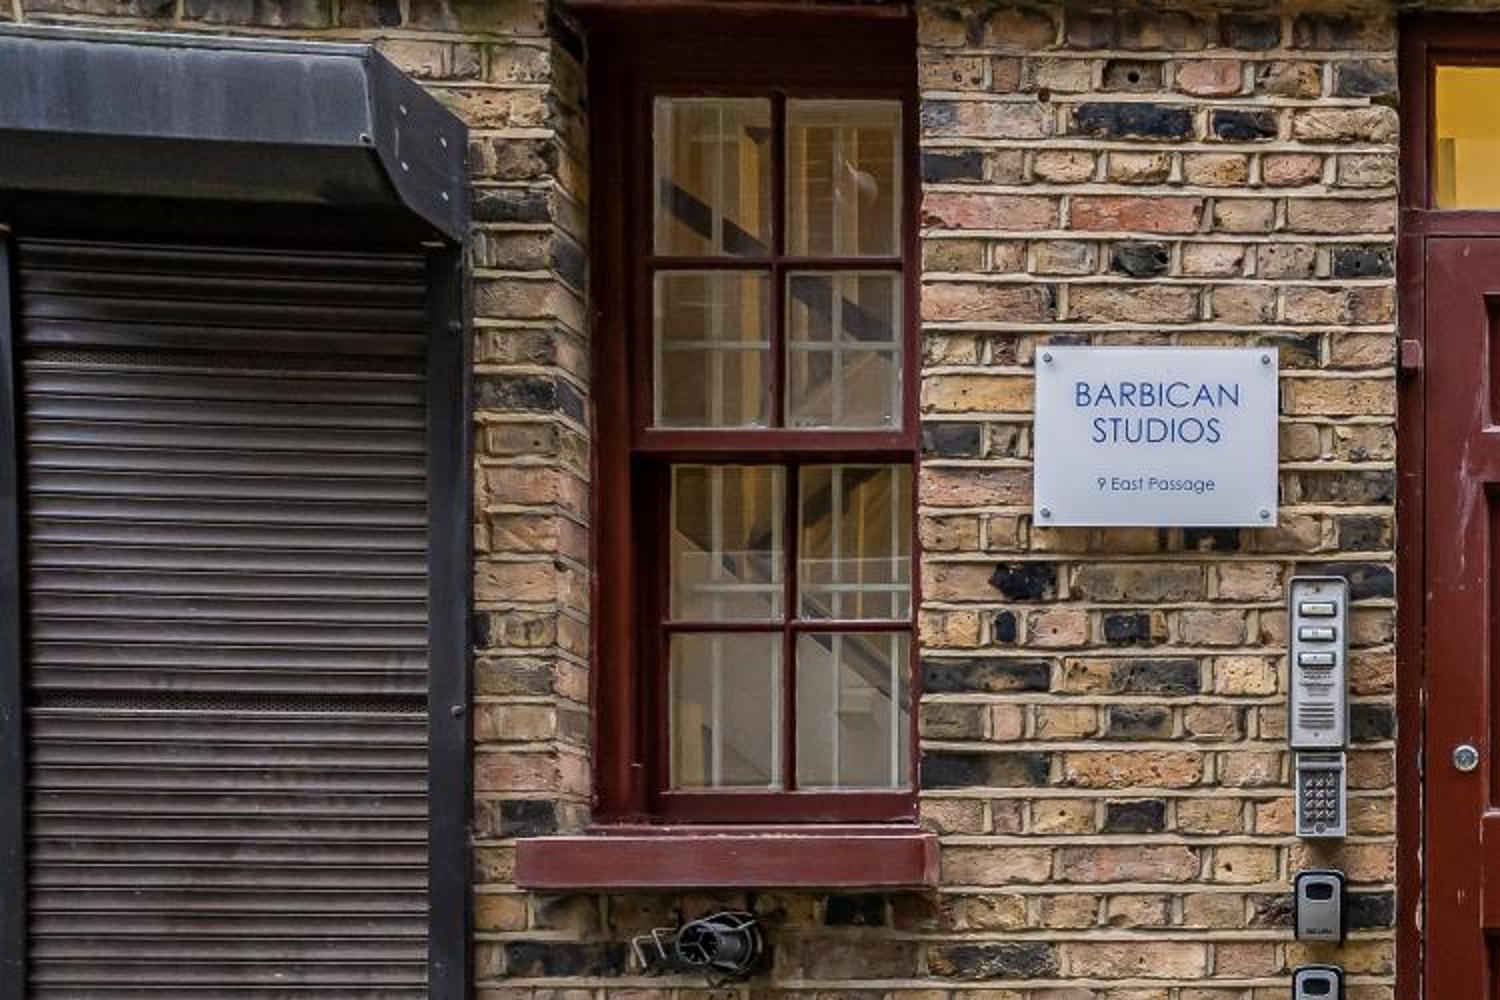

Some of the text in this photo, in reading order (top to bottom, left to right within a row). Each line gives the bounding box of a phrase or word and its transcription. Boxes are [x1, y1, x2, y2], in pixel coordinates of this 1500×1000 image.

[1075, 381, 1240, 408] BARBICAN
[1092, 417, 1222, 444] STUDIOS
[1111, 477, 1143, 491] East
[1148, 477, 1216, 494] Passage
